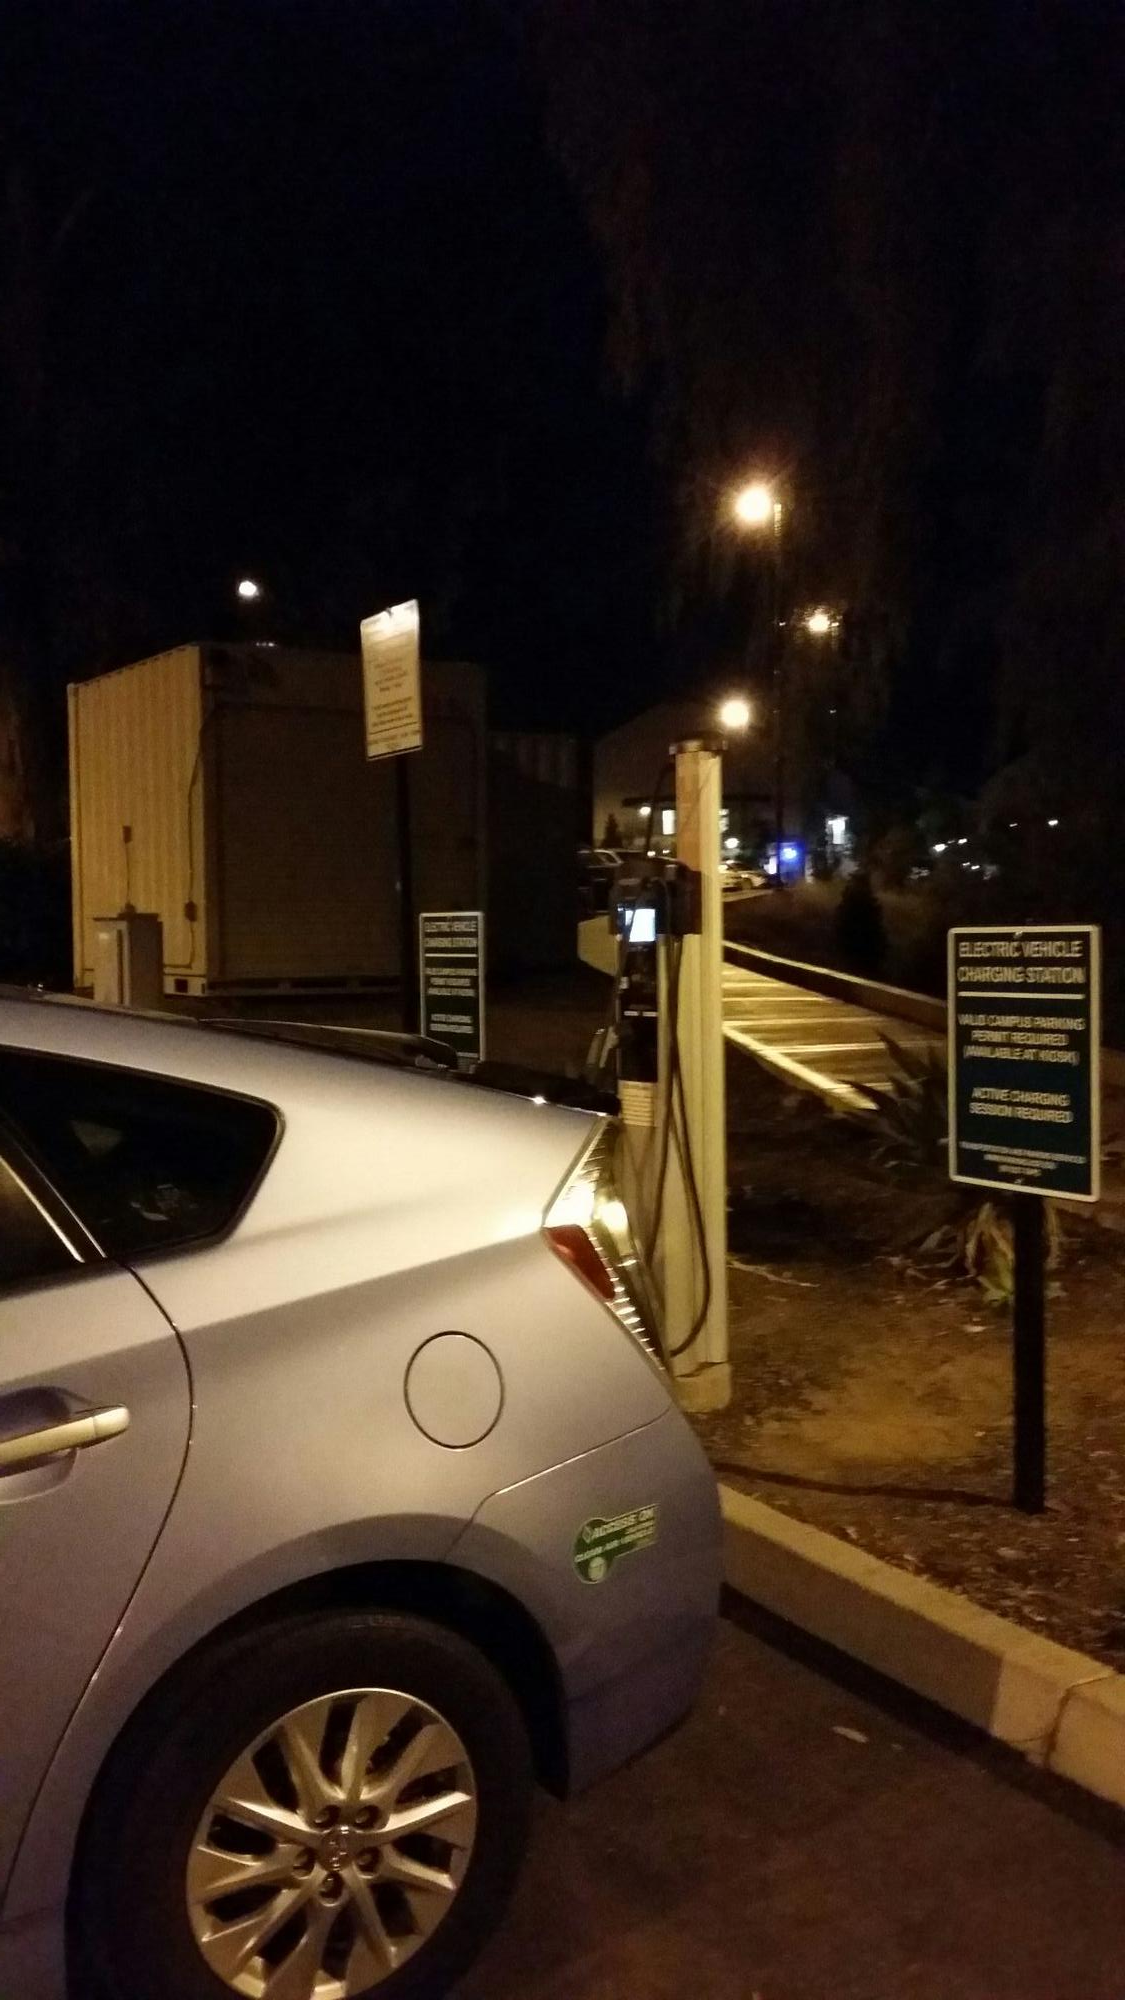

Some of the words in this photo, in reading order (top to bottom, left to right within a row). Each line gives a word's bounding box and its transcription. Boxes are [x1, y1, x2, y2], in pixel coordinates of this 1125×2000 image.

[959, 941, 1020, 958] ELECTRIC
[1021, 941, 1084, 958] VEHICLE
[957, 967, 1025, 983] CHARGING
[1025, 967, 1086, 984] STATION
[957, 1014, 987, 1025] VALID
[988, 1015, 1031, 1028] CAMPUS
[1033, 1016, 1086, 1031] PARKING
[971, 1030, 1009, 1043] PERMIT
[1011, 1032, 1069, 1046] REQUIRED
[972, 1087, 1011, 1101] ACTIVE
[1011, 1089, 1071, 1106] CHARGING
[969, 1102, 1013, 1117] SESSION
[1014, 1106, 1075, 1124] REQUIRED
